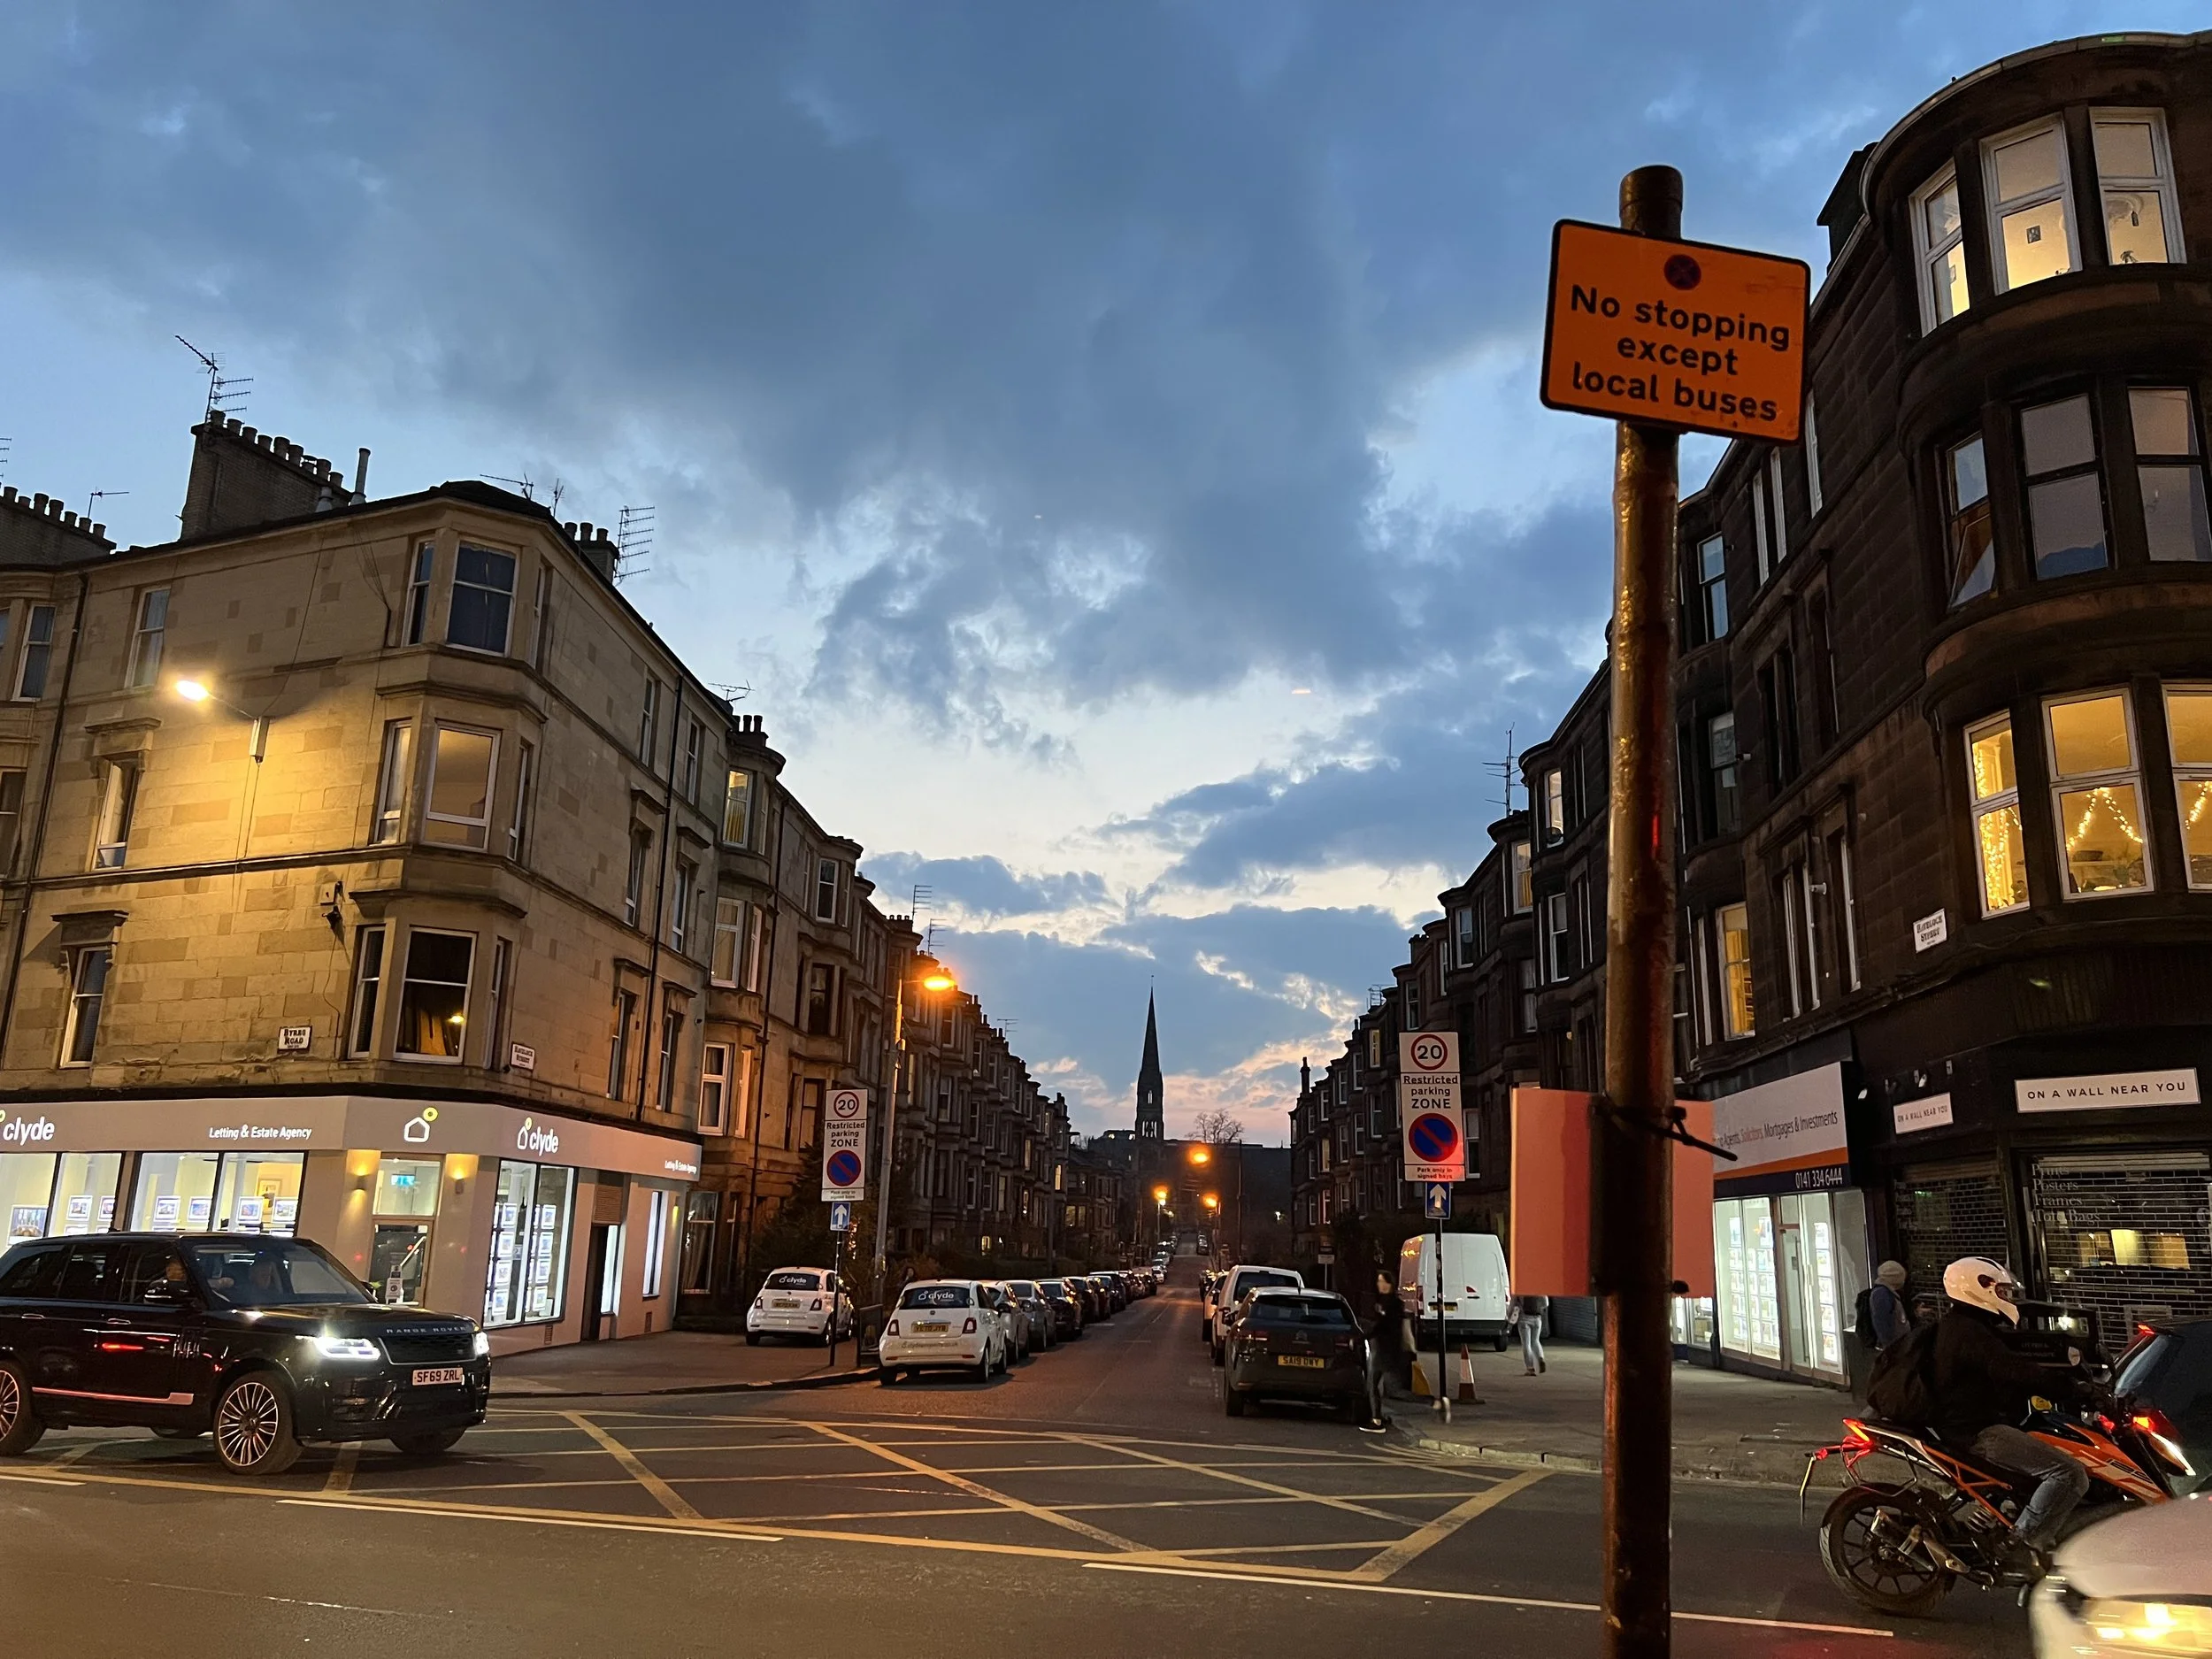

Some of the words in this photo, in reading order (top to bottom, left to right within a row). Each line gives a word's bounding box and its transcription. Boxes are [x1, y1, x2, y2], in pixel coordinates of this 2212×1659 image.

[1571, 284, 1620, 318] No
[1634, 300, 1789, 351] stopping
[1617, 337, 1738, 375] except
[1571, 361, 1659, 403] local
[1673, 378, 1778, 422] buses
[1920, 927, 1940, 942] STREET
[1417, 1045, 1443, 1059] 20
[1403, 1075, 1458, 1085] Restricted
[1411, 1087, 1450, 1096] parking
[2027, 1091, 2045, 1100] ON
[2066, 1087, 2104, 1097] WALL
[2110, 1084, 2149, 1094] NEAR
[2155, 1082, 2185, 1092] YOU
[838, 1099, 856, 1110] 20
[1411, 1098, 1451, 1109] ZONE
[1924, 1108, 1936, 1117] NEAR
[3, 1116, 55, 1146] clyde
[1763, 1121, 1794, 1140] Mortgages
[1794, 1117, 1800, 1131] &
[1800, 1110, 1838, 1131] Investments
[209, 1127, 240, 1141] Letting
[240, 1124, 250, 1138] &
[250, 1126, 279, 1139] Estate
[279, 1126, 311, 1140] Agency
[831, 1130, 859, 1139] parking
[530, 1126, 559, 1156] clyde
[830, 1139, 858, 1148] ZONE
[1794, 1171, 1811, 1189] 0141
[1812, 1169, 1825, 1187] 334
[1825, 1167, 1843, 1187] 6444
[2033, 1179, 2079, 1191] Posters
[2034, 1194, 2083, 1207] Frames
[2069, 1209, 2101, 1225] Bags
[928, 1290, 955, 1300] clyde
[417, 1371, 442, 1383] SF69
[443, 1369, 459, 1382] ZRL
